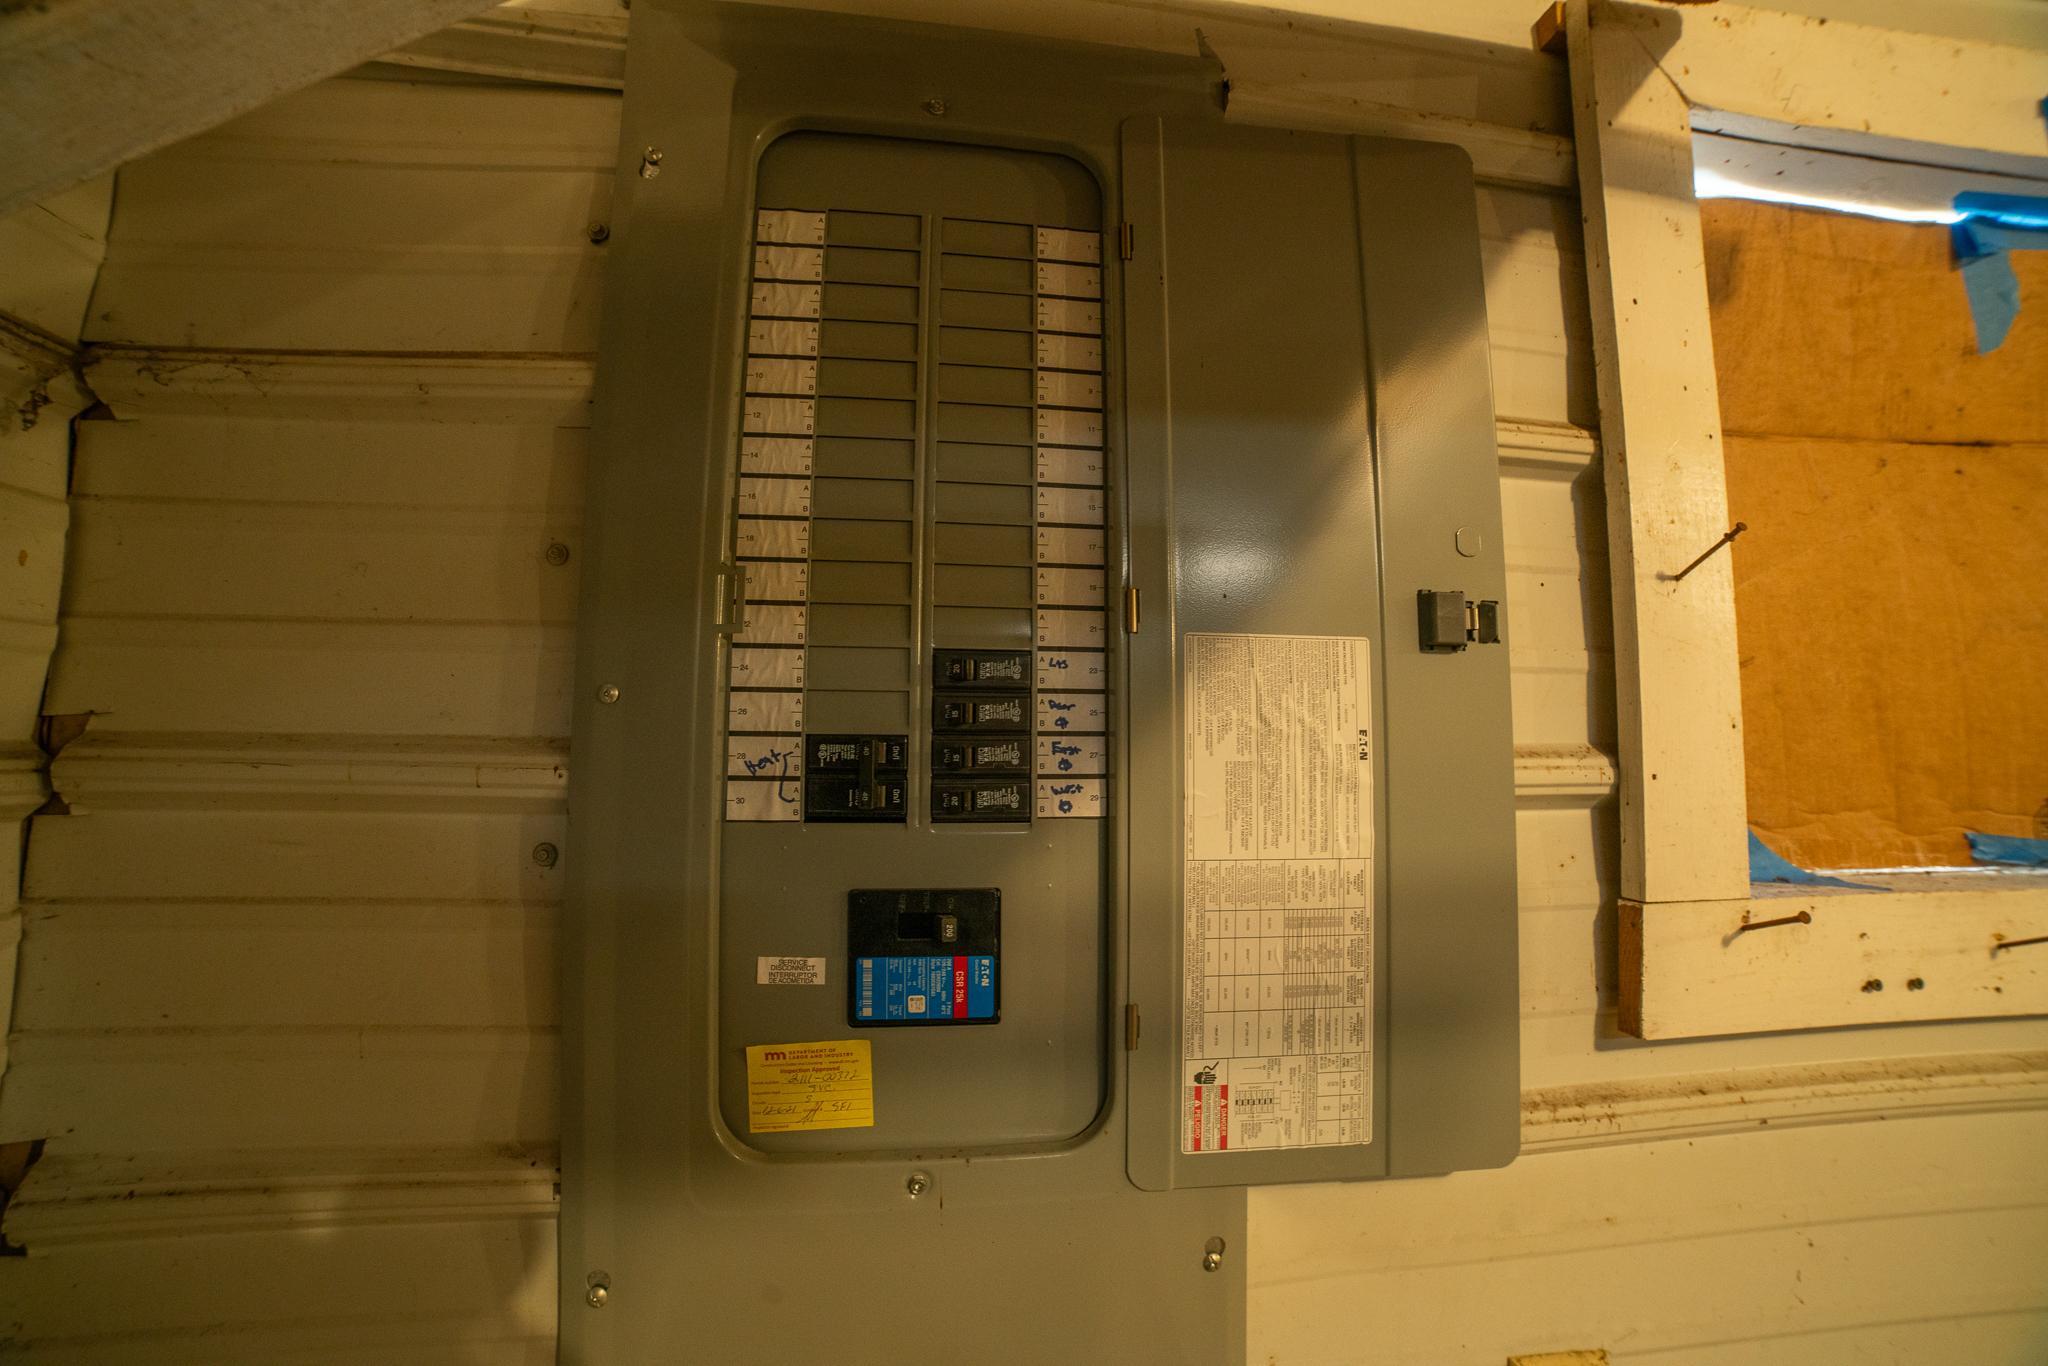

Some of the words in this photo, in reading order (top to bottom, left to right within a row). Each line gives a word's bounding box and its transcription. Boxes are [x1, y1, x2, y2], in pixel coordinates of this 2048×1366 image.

[953, 664, 960, 673] 20
[952, 796, 958, 806] 20
[956, 971, 964, 987] CSR
[956, 989, 964, 1003] 25k
